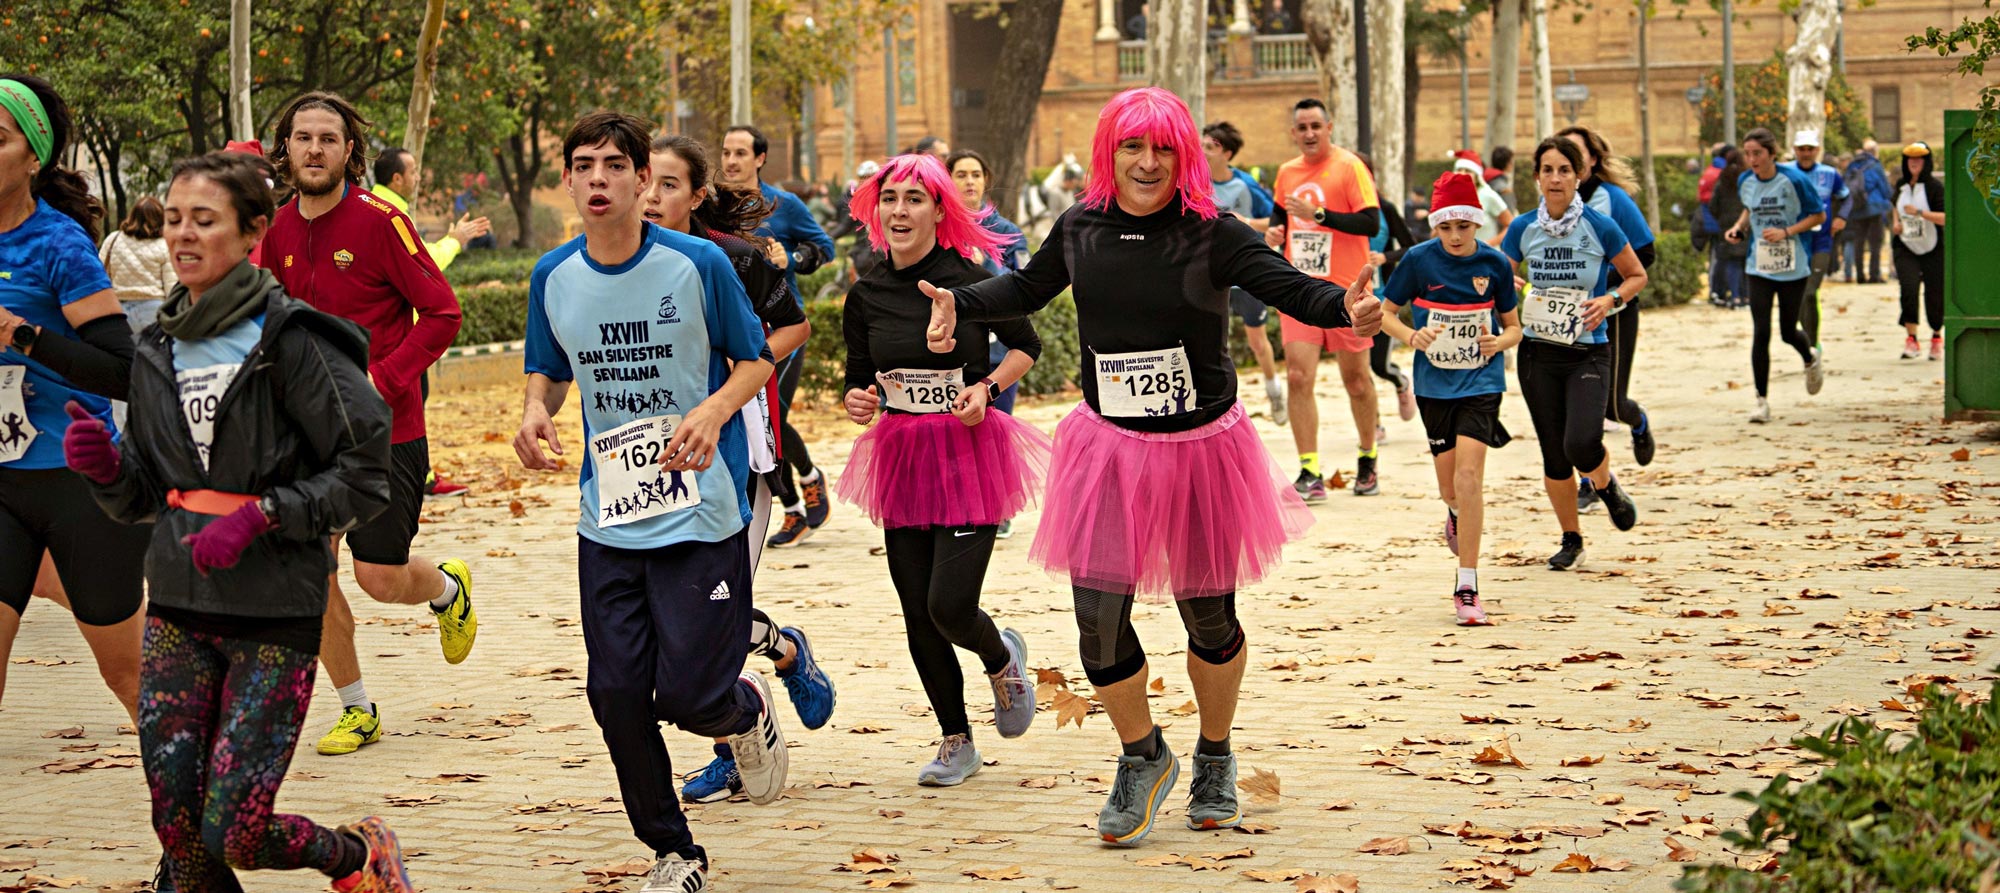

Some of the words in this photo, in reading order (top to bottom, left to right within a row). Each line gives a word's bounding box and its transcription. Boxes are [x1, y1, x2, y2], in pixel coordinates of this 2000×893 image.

[1302, 242, 1324, 253] 347
[1544, 247, 1573, 261] XXVIII
[1544, 260, 1588, 271] SILVESTRE
[1533, 272, 1578, 281] SEVILLANA
[1547, 300, 1577, 317] 972
[598, 320, 650, 346] XXVIII
[577, 350, 604, 365] SAN
[605, 343, 673, 363] SILVESTRE
[1137, 355, 1164, 364] SILVESTRE
[1100, 359, 1125, 373] XXVIII
[1126, 363, 1155, 372] SEVILLANA
[593, 365, 660, 383] SEVILLANA
[1125, 369, 1186, 397] 1285
[905, 384, 959, 405] 1286
[627, 422, 654, 435] SILVESTRE
[594, 431, 620, 454] XXVIII
[620, 432, 645, 446] SEVILLANA
